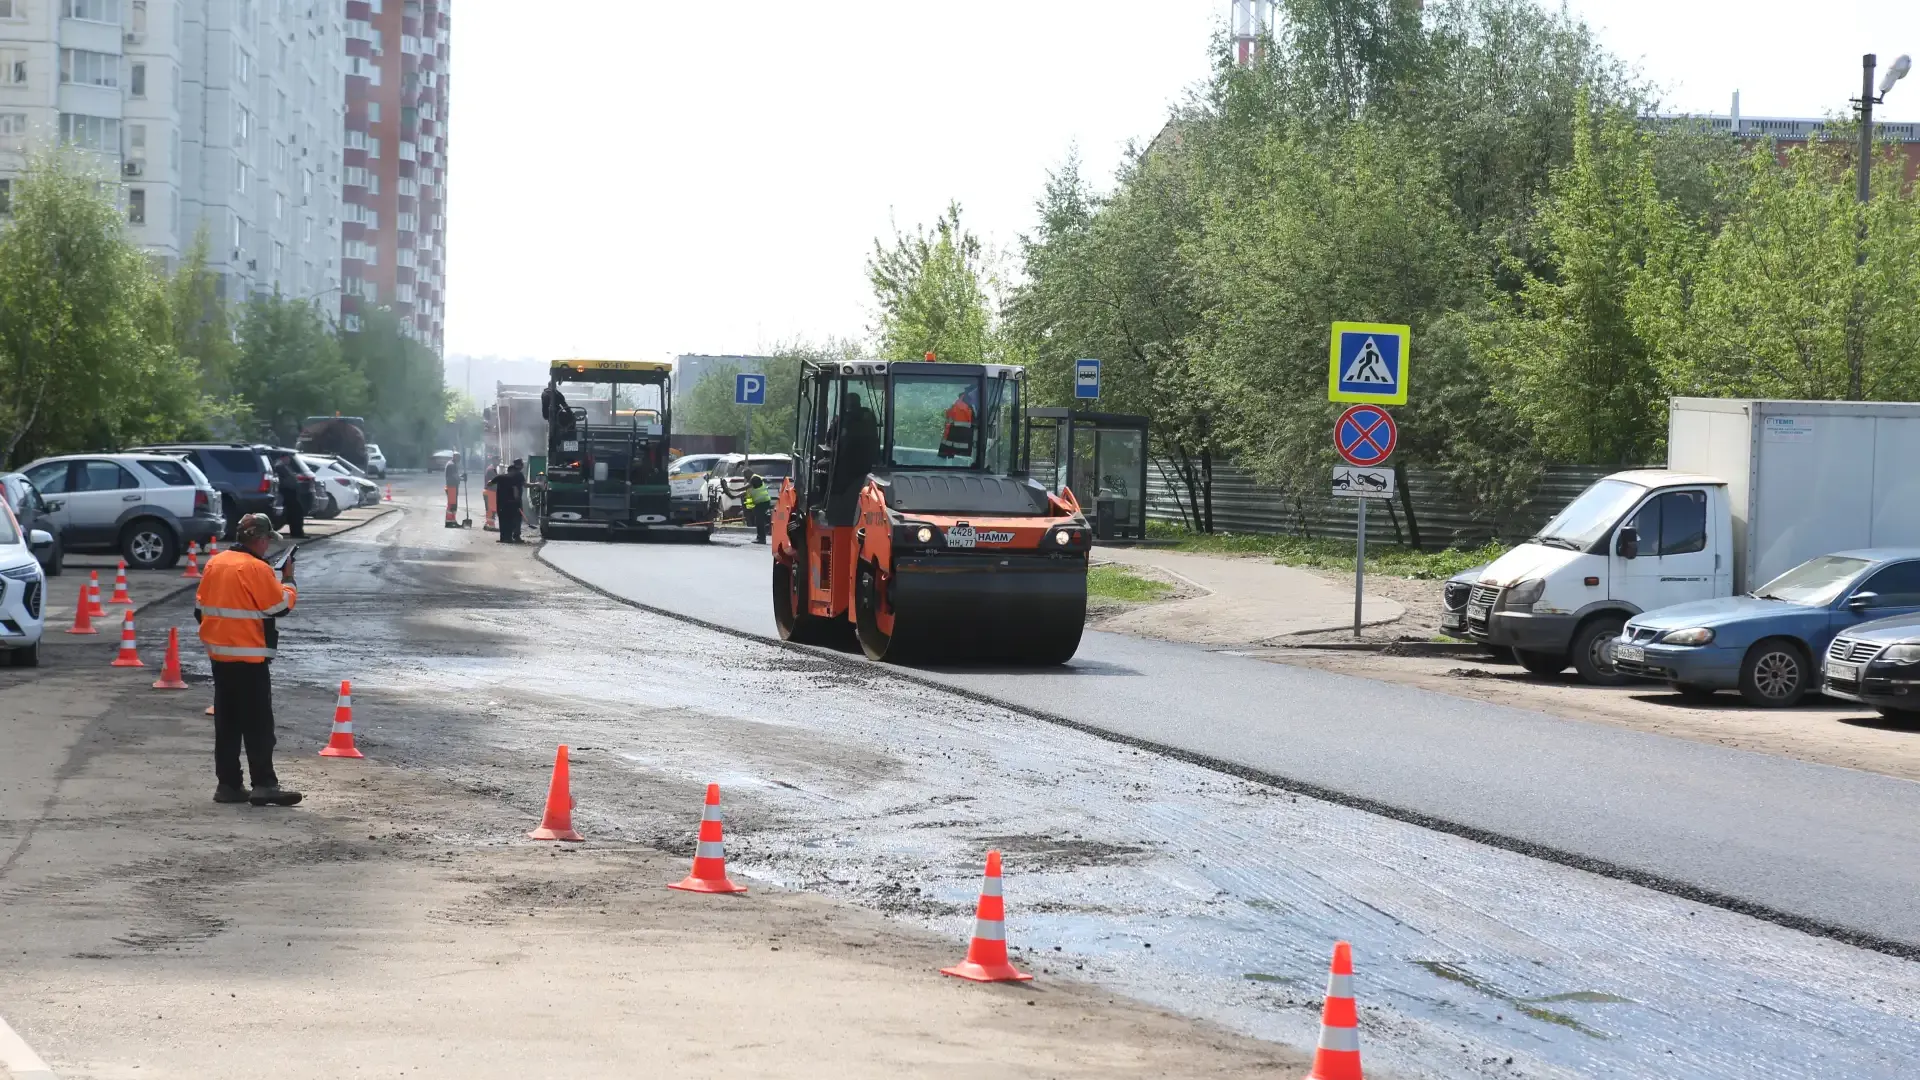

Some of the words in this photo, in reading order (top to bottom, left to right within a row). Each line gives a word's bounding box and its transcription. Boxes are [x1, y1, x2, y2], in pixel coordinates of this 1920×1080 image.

[743, 377, 760, 401] P
[951, 527, 973, 537] 4428
[978, 533, 1008, 542] HAMM
[965, 539, 974, 547] 77
